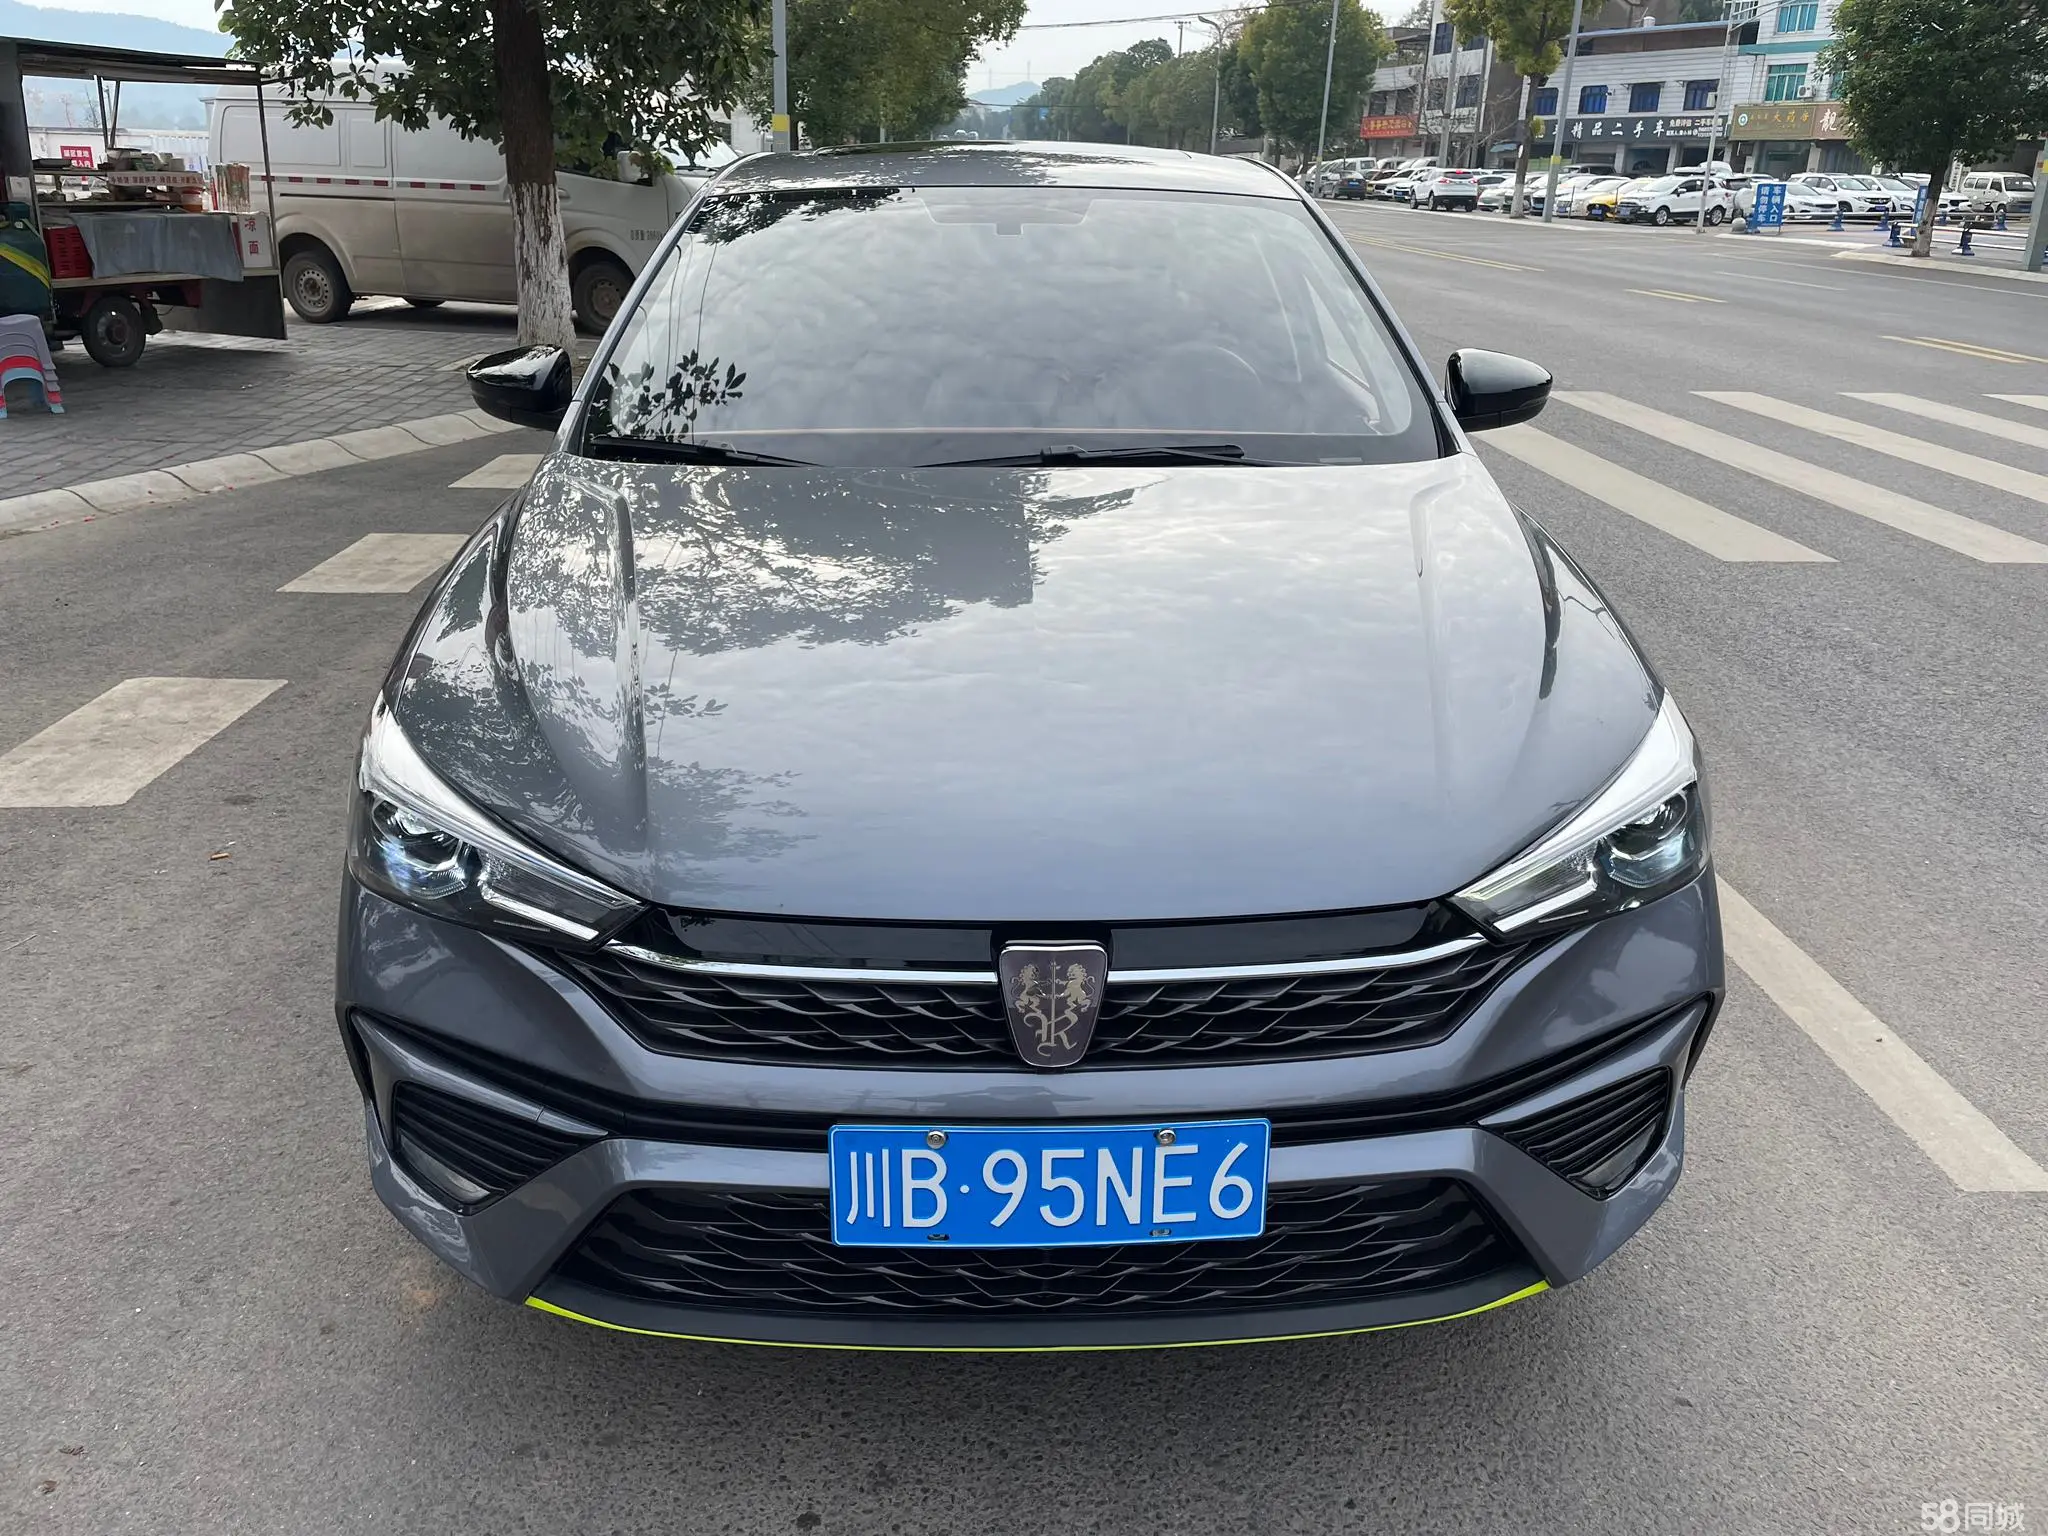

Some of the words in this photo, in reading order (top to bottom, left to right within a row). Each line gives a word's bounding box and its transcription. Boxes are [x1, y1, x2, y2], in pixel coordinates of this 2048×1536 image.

[1820, 108, 1837, 132] 靓
[1757, 186, 1770, 222] 请勿停车
[1769, 186, 1782, 222] 车辆入口
[244, 216, 259, 255] 凉面
[846, 1142, 1254, 1228] 川B·95NE6
